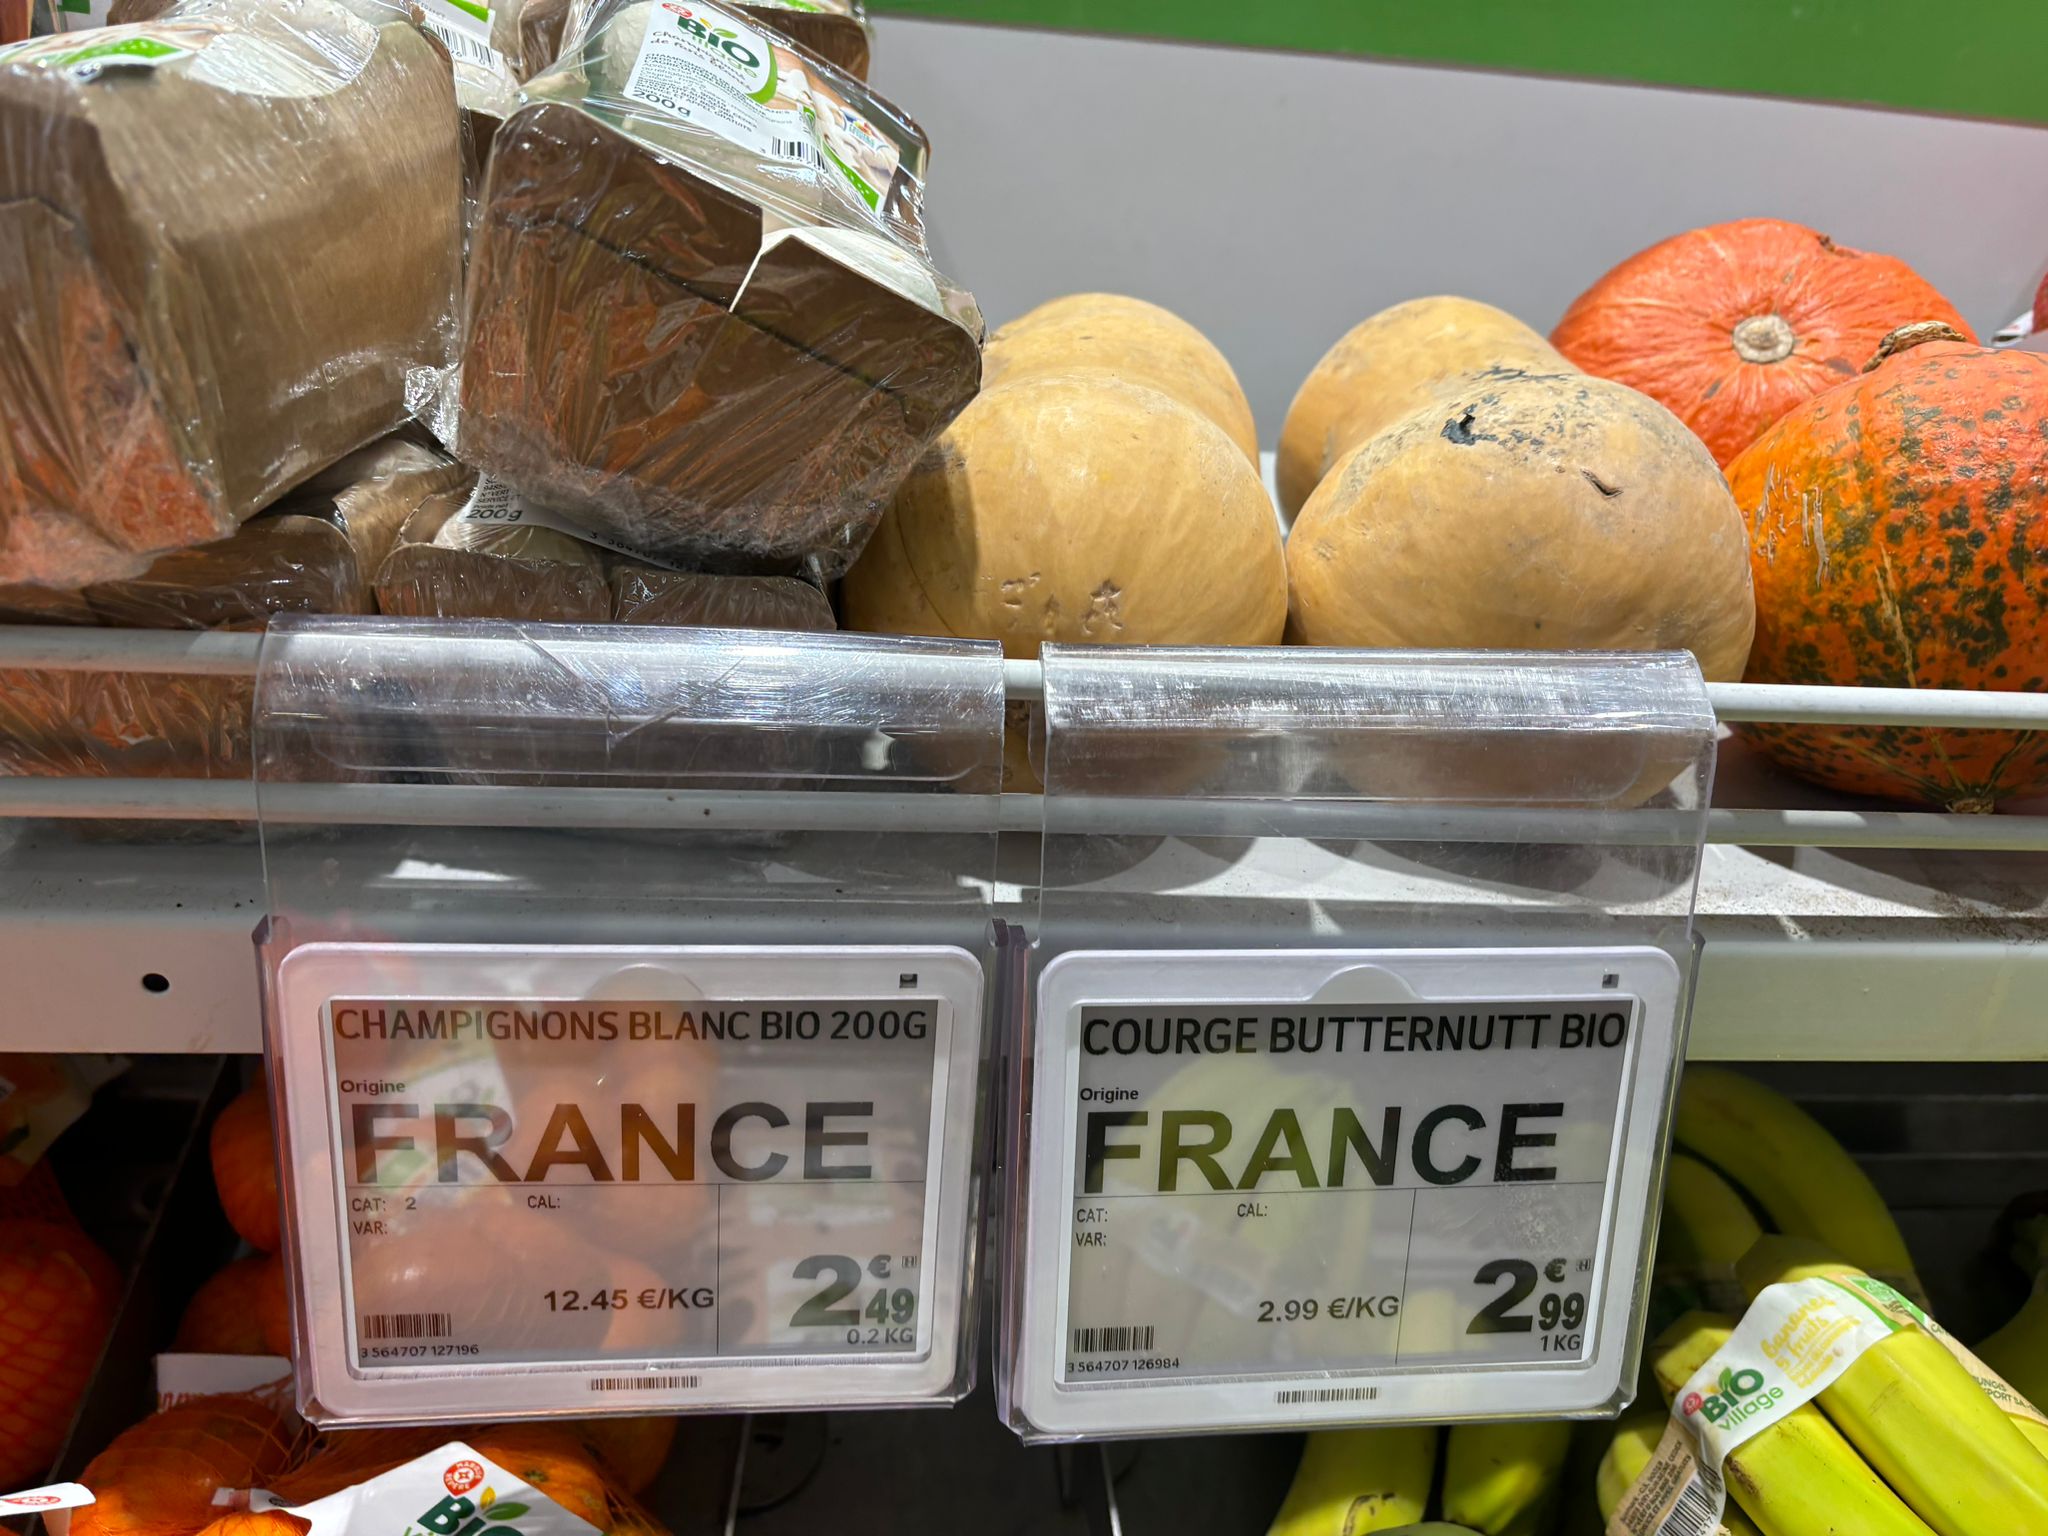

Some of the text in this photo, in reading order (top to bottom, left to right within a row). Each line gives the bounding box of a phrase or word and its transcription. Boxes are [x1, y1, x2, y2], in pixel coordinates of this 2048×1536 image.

[335, 1009, 927, 1041] CHAMPIGNONS BLANC BIO 200G
[1083, 1012, 1626, 1055] COURGE BUTTERNUTT BIO
[340, 1080, 406, 1095] Origine
[1080, 1087, 1139, 1104] Origine
[352, 1102, 874, 1184] FRANCE
[1084, 1102, 1564, 1194] FRANCE
[352, 1197, 417, 1212] CAT: 2
[527, 1195, 560, 1209] CAL:
[1076, 1208, 1108, 1223] CAT:
[1236, 1203, 1267, 1218] CAL:
[353, 1221, 388, 1235] VAR:
[1075, 1232, 1107, 1247] VAR:
[543, 1288, 715, 1312] 12.45 €/KG
[1257, 1296, 1399, 1322] 2.99 €/KG
[846, 1327, 913, 1344] 0.2 KG
[1541, 1333, 1581, 1352] 1 KG
[371, 1346, 427, 1358] 564707
[430, 1344, 480, 1357] 127196
[1078, 1360, 1129, 1373] 564707
[1132, 1358, 1180, 1371] 126984
